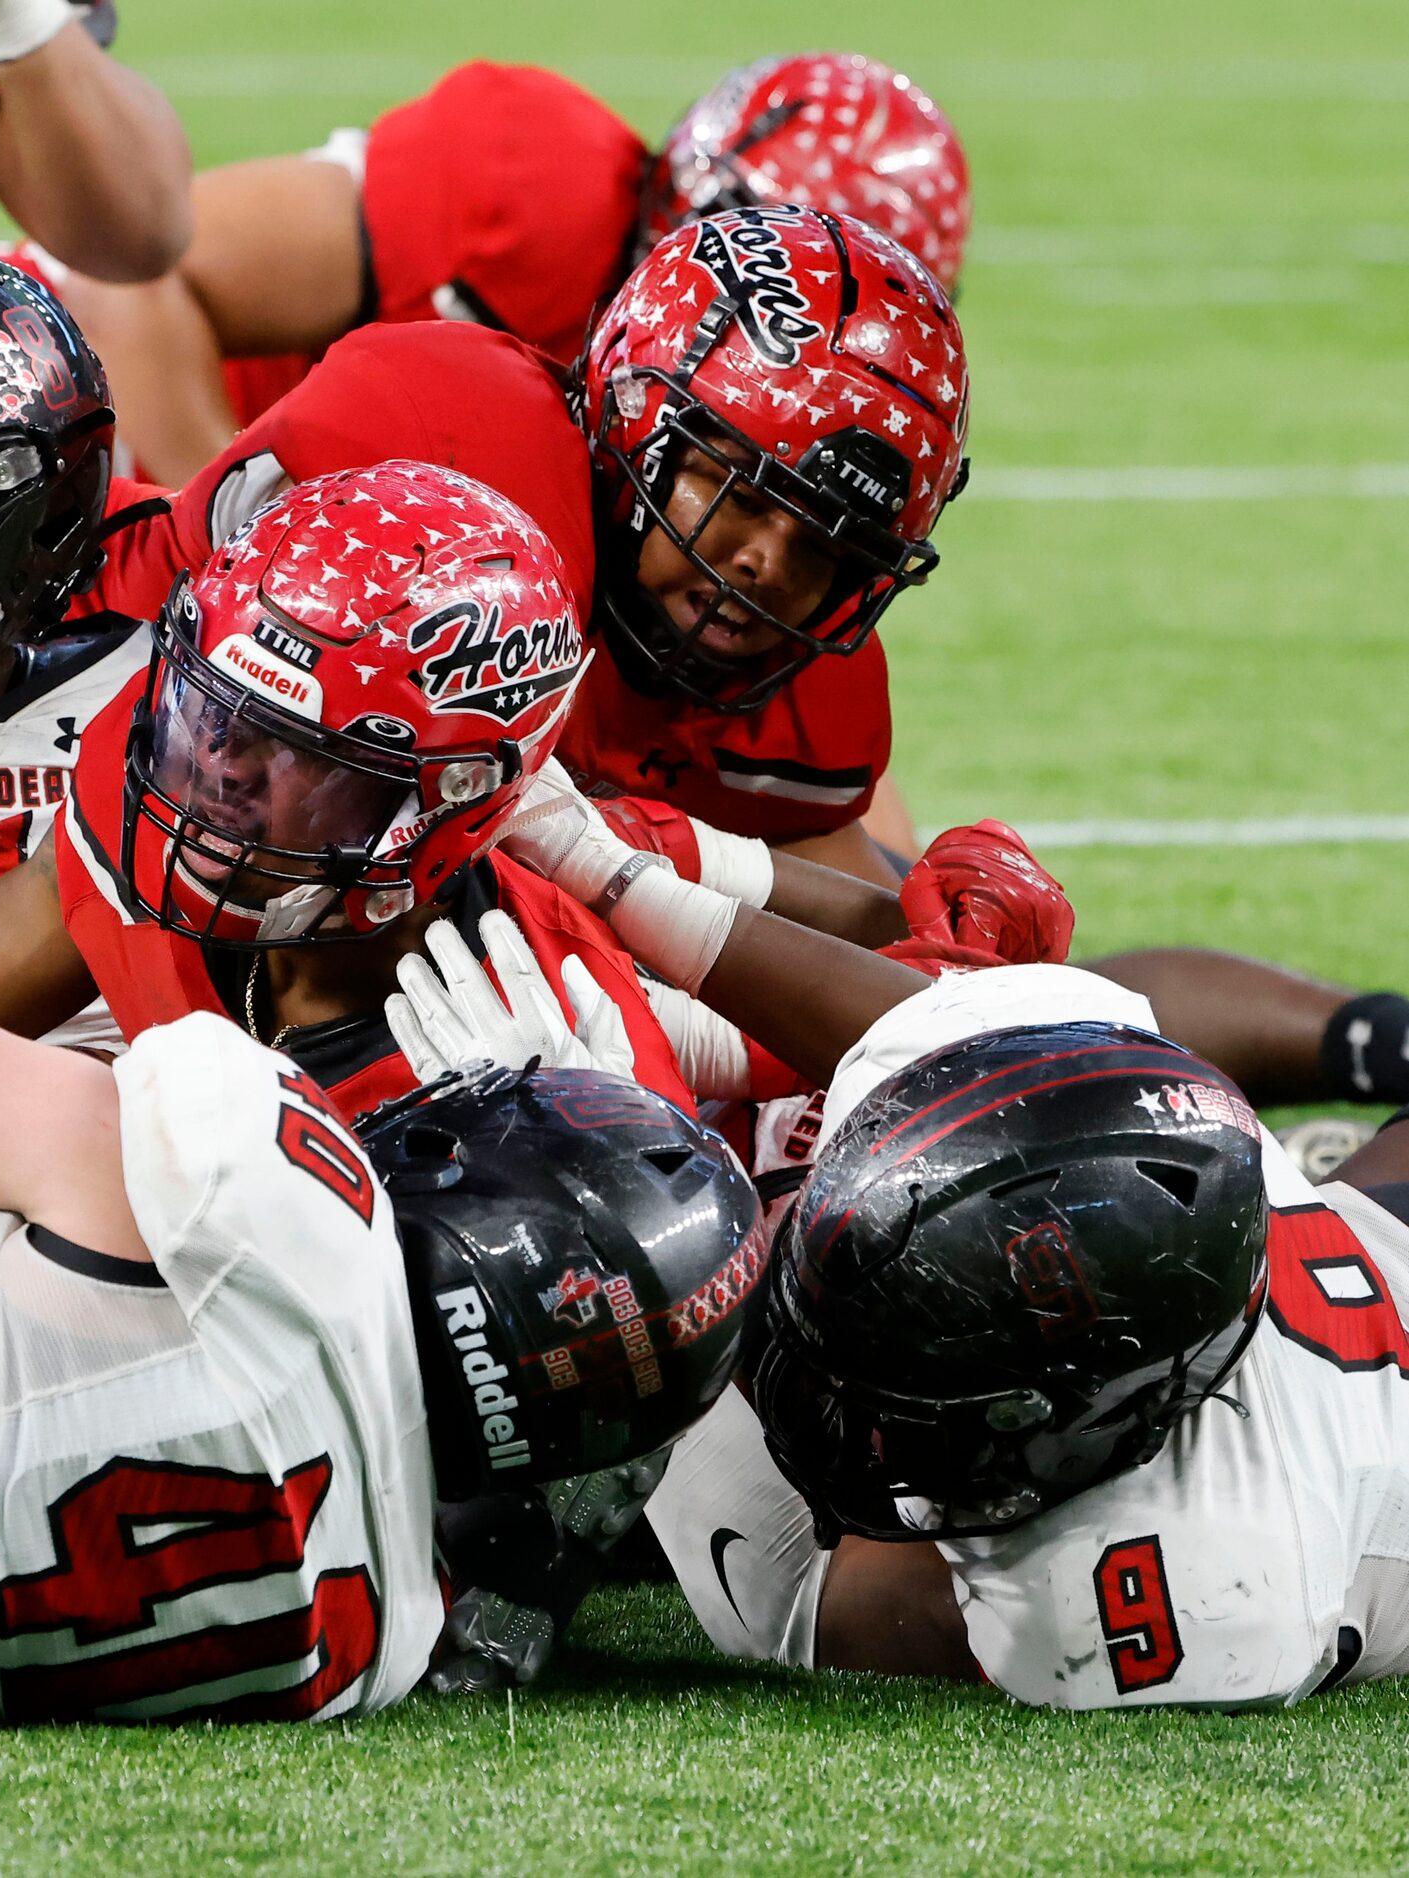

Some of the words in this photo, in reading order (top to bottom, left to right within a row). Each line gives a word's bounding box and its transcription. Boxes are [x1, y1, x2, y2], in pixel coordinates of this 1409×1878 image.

[2, 305, 78, 410] 8
[838, 459, 888, 505] TTHL
[258, 620, 313, 669] TTHL
[606, 853, 649, 901] FAMILY
[602, 1275, 643, 1322] 903
[618, 1317, 654, 1363] 903
[434, 1284, 532, 1470] Riddell
[542, 1346, 580, 1391] 903
[1093, 1534, 1185, 1695] 9
